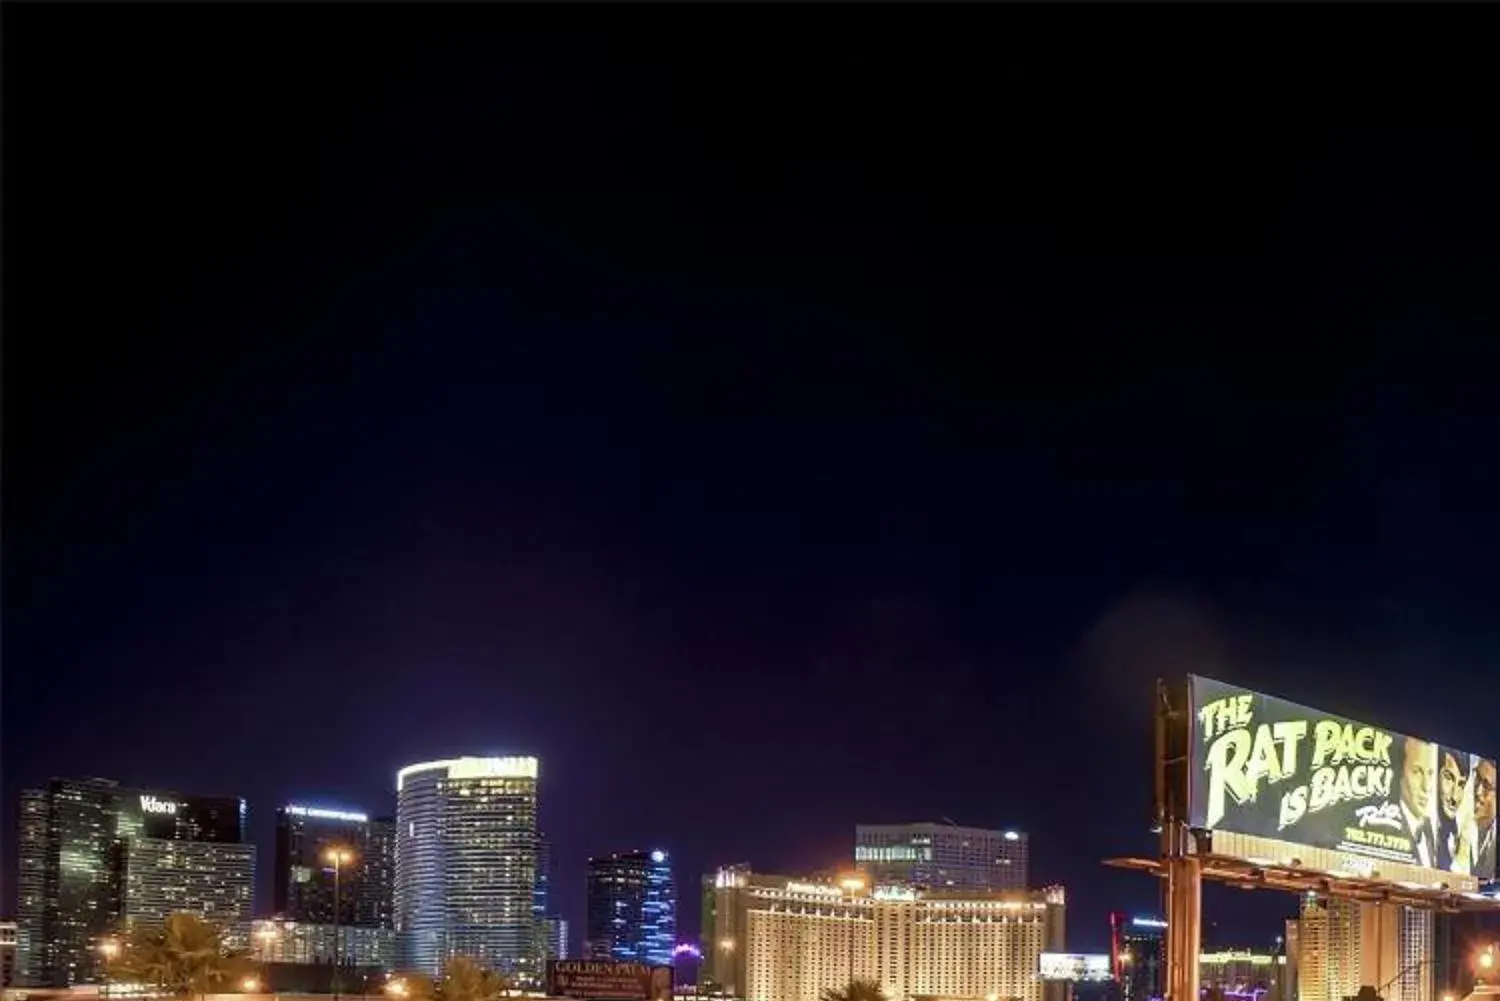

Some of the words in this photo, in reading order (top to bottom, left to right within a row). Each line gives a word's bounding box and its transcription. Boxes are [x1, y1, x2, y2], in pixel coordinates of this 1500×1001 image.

[1199, 695, 1253, 742] THE
[1204, 720, 1307, 829] RAT
[1311, 720, 1393, 769] PACK
[1278, 785, 1308, 831] IS
[1308, 766, 1394, 812] BACK!
